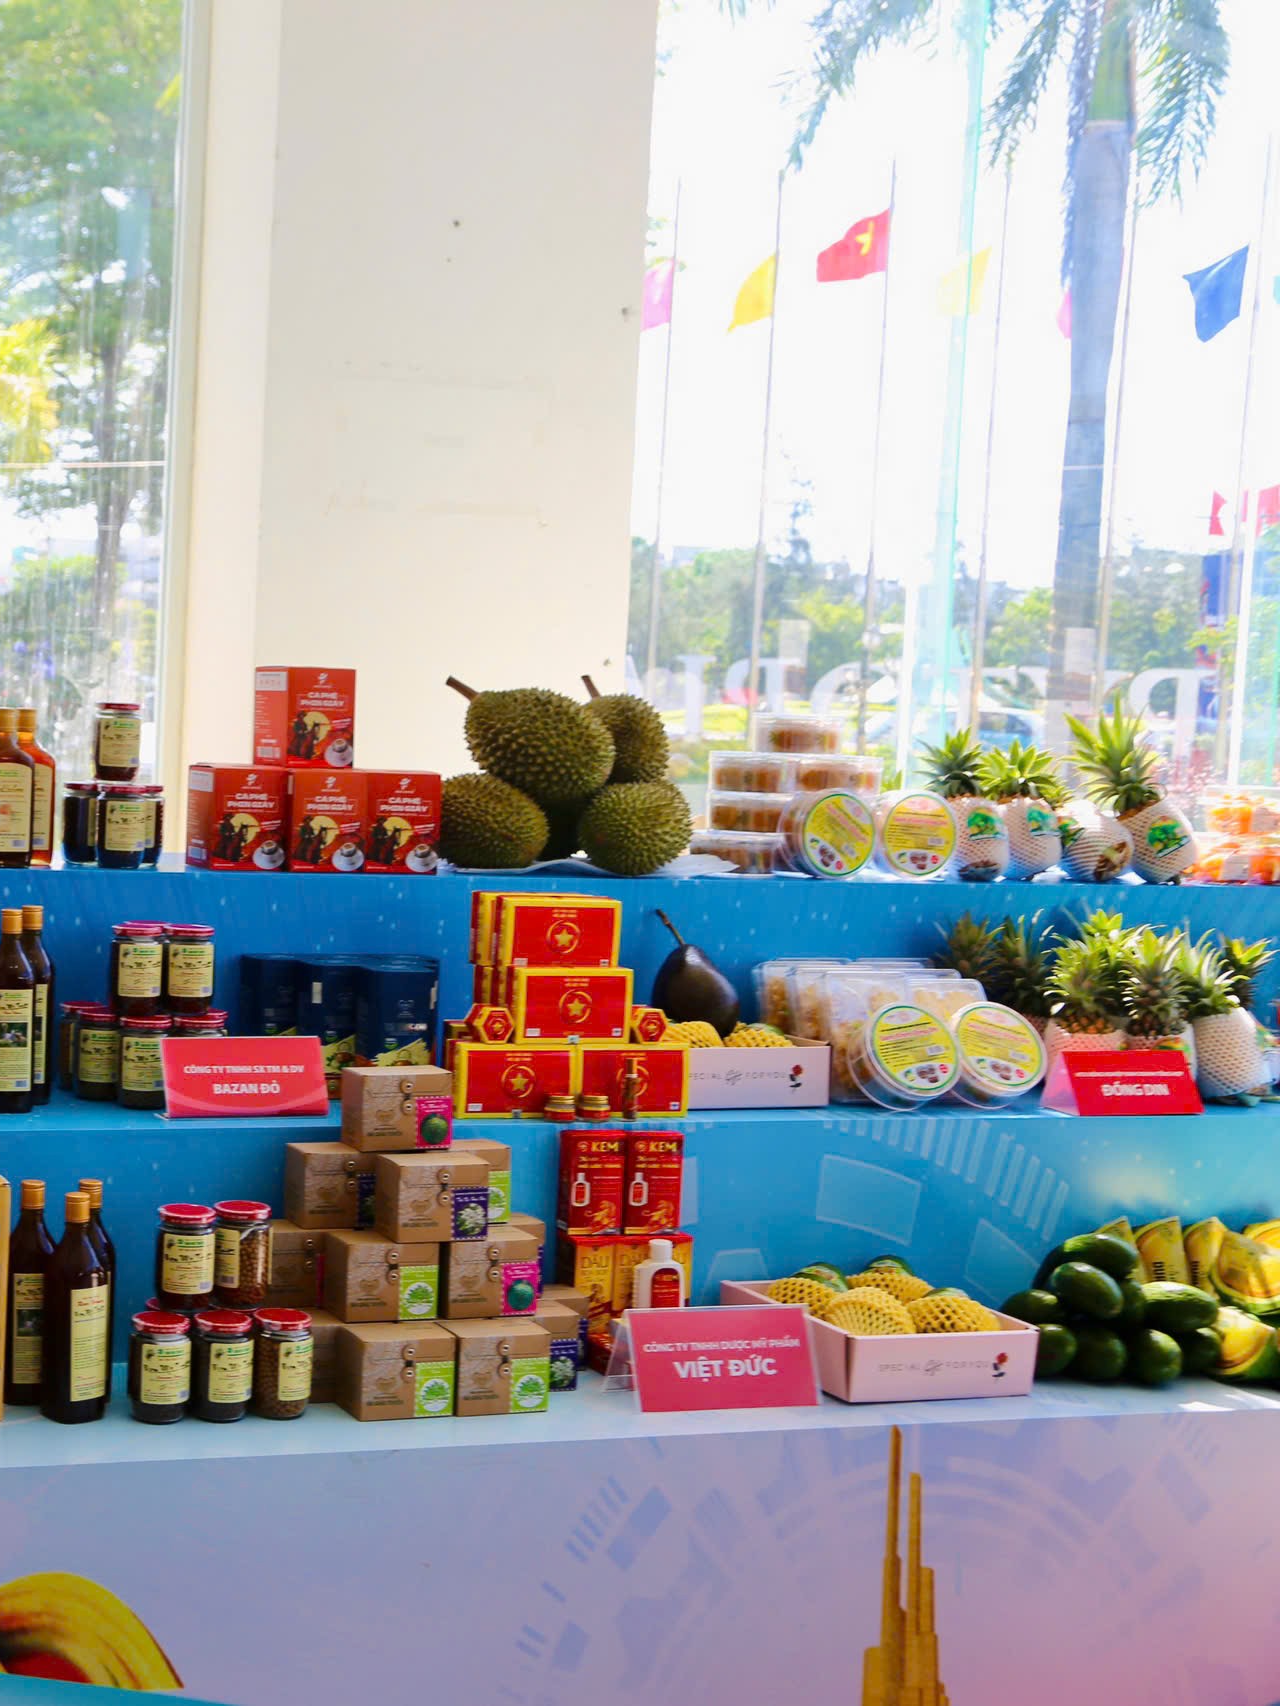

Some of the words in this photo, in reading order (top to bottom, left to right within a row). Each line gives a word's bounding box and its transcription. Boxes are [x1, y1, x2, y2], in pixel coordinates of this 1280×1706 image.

[183, 1064, 210, 1074] CÔNG
[211, 1065, 225, 1074] TY
[212, 1082, 259, 1095] BAZAN
[260, 1079, 281, 1095] ĐỎ
[590, 1141, 619, 1153] KEM
[649, 1141, 678, 1153] KEM
[642, 1341, 674, 1353] CÔNG
[674, 1342, 689, 1351] TY
[691, 1341, 720, 1351] TNHH
[721, 1340, 751, 1351] DƯỢC
[672, 1355, 724, 1382] VIỆT
[727, 1353, 778, 1377] ĐỨC
